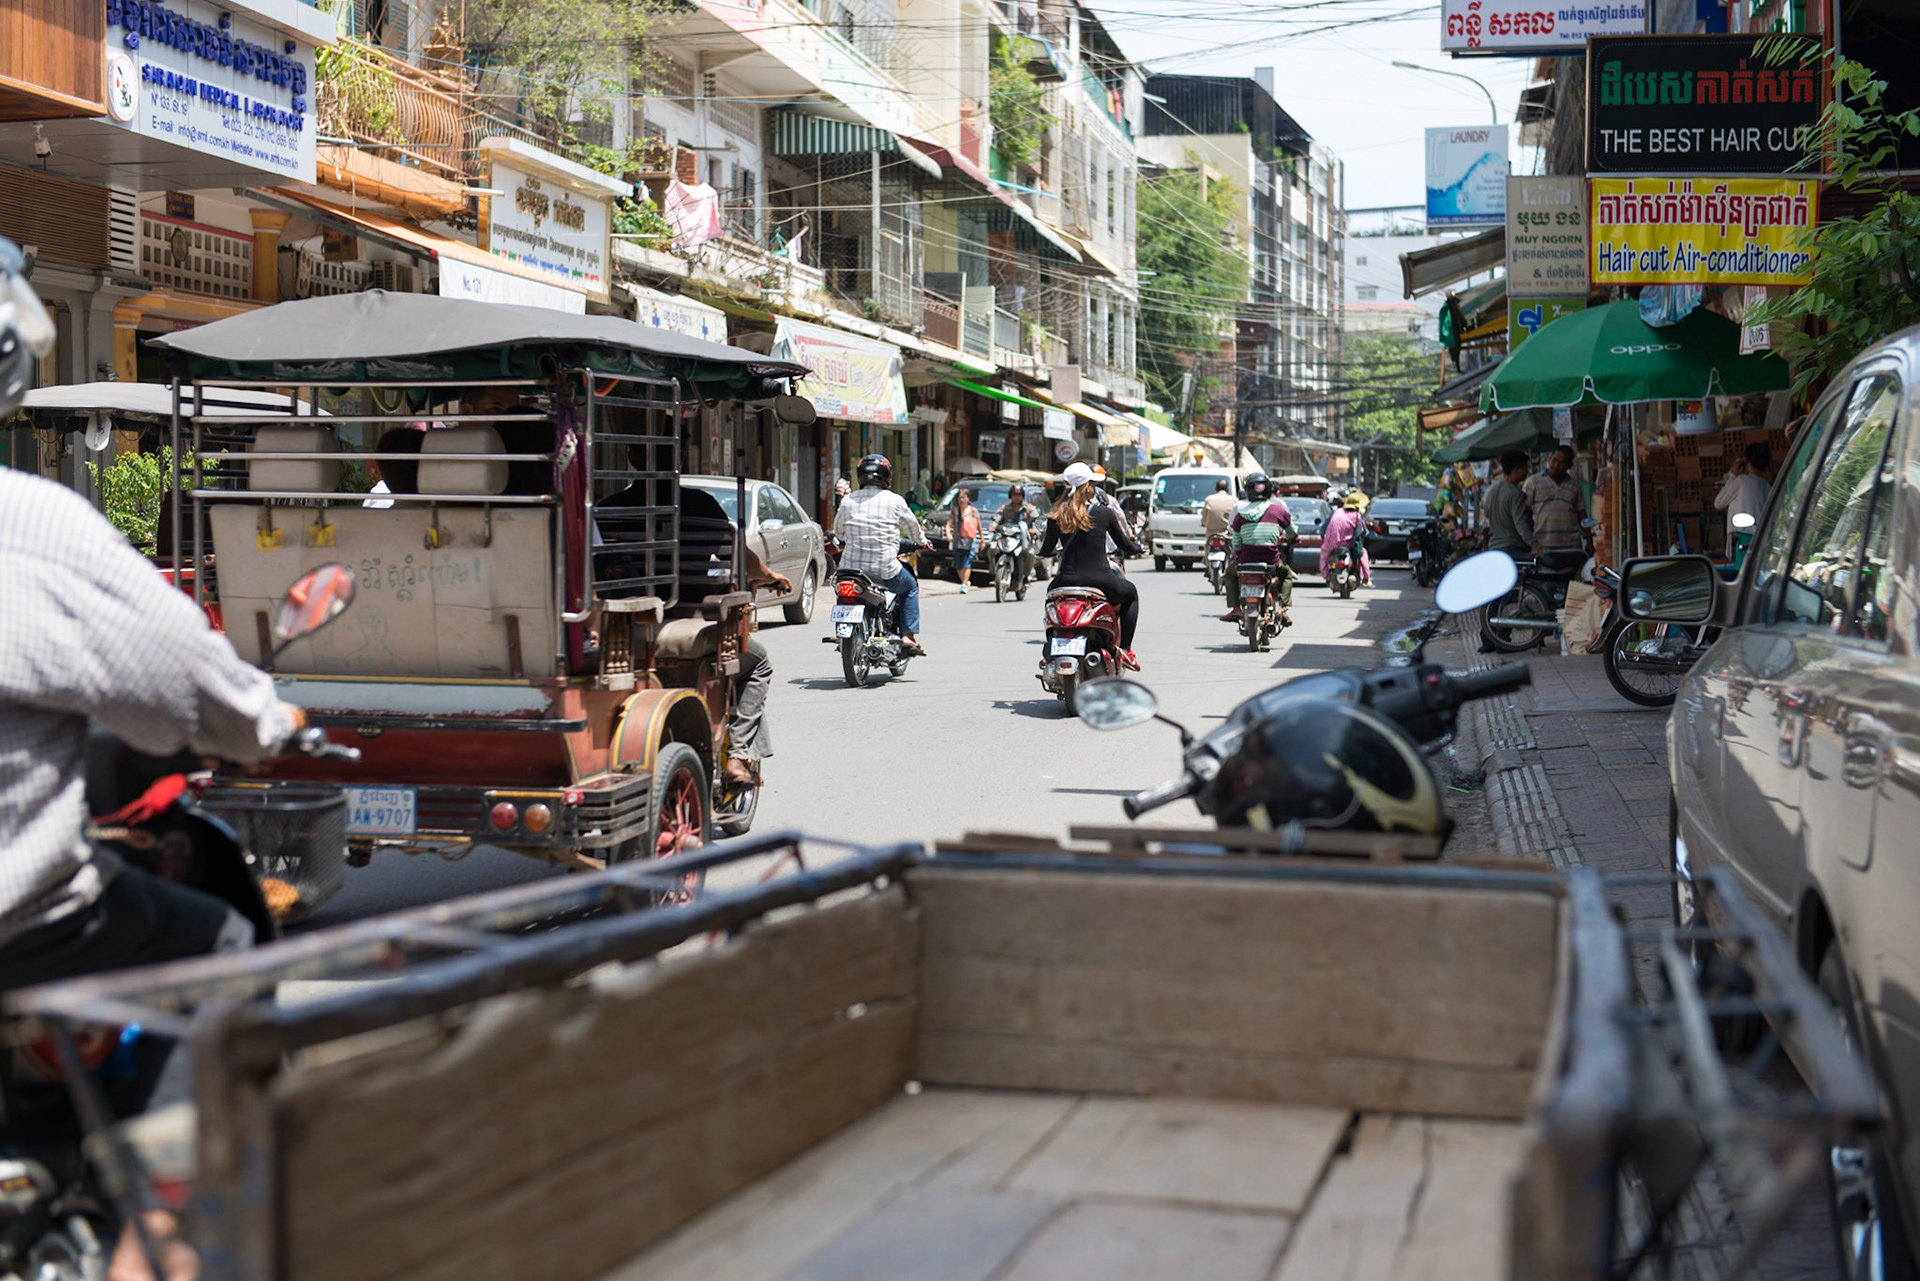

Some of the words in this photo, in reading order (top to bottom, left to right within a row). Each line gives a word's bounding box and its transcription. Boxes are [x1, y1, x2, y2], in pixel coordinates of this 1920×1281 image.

[1488, 11, 1555, 36] សកល
[200, 83, 242, 112] MEDICAL
[245, 97, 305, 132] LABORATORY
[1450, 131, 1490, 144] LAUNDRY
[1600, 128, 1642, 154] THE
[1649, 127, 1705, 153] BEST
[1710, 127, 1761, 152] HAIR
[1767, 126, 1812, 152] CUT
[1514, 235, 1539, 244] MUY
[1542, 235, 1583, 244] NGORN
[1599, 242, 1637, 272] Hair
[1639, 244, 1670, 273] cut
[1673, 241, 1811, 274] Air-conditioner
[1533, 268, 1542, 279] &
